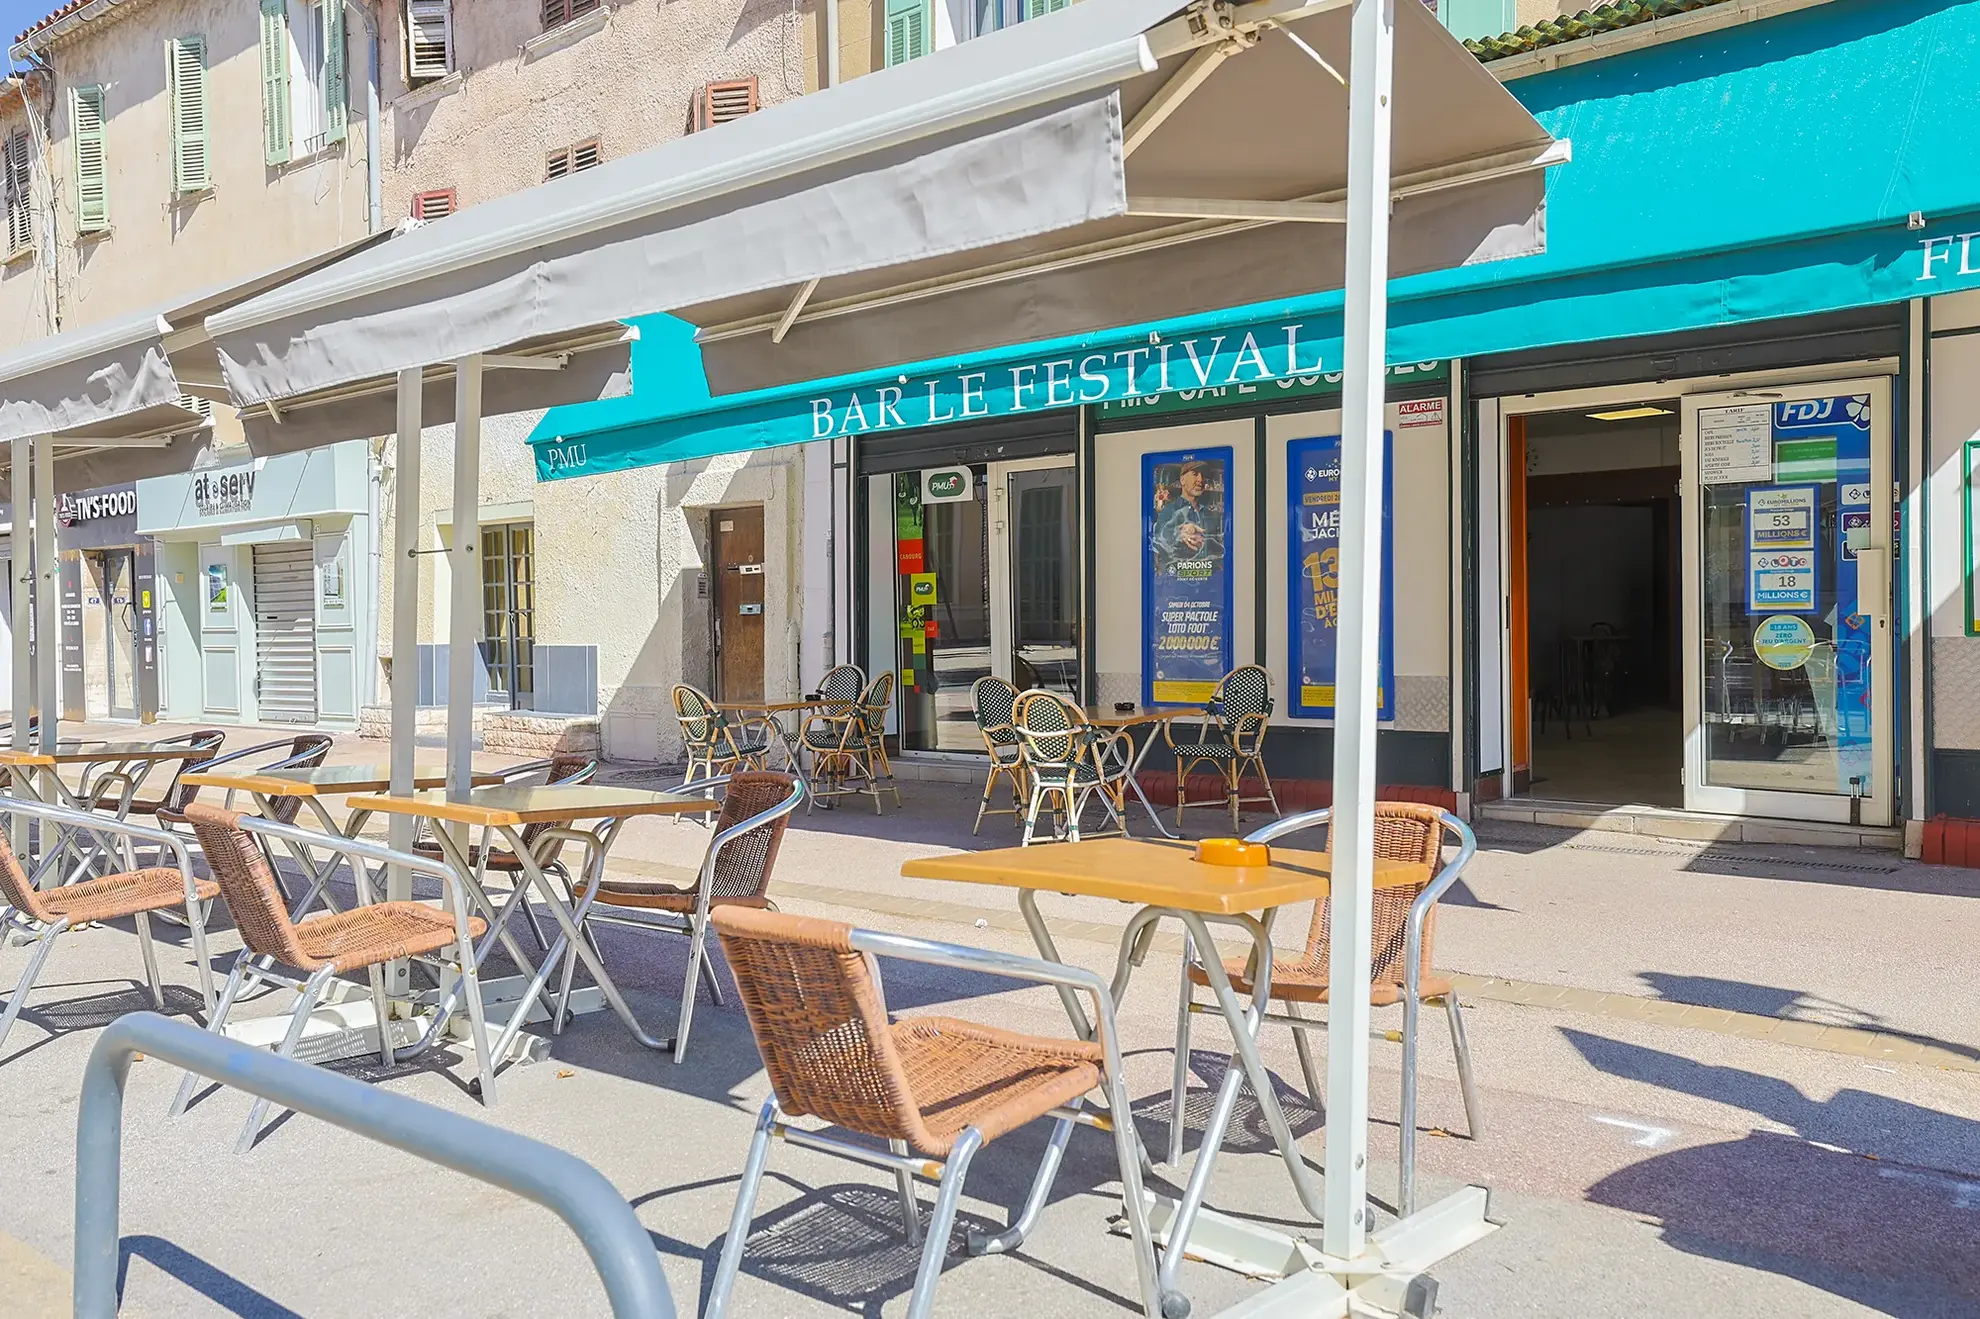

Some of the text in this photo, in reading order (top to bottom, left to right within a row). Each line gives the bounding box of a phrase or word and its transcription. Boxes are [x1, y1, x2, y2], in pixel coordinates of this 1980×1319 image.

[809, 324, 1323, 438] BAR LE FESTIVAL
[1400, 401, 1441, 413] ALARME
[1781, 398, 1835, 421] FDJ
[547, 443, 587, 470] PMU
[932, 481, 950, 491] PMU
[75, 491, 136, 520] TN'S FOOD
[1773, 515, 1790, 526] 53
[1757, 530, 1799, 538] MILLIONS
[1177, 561, 1212, 569] PARIONS
[1771, 555, 1808, 567] LOTO
[1779, 576, 1796, 587] 18
[1757, 591, 1799, 599] MILLIONS
[1161, 610, 1219, 621] SUPER PACTOLE
[1168, 622, 1209, 633] LOTO FOOT
